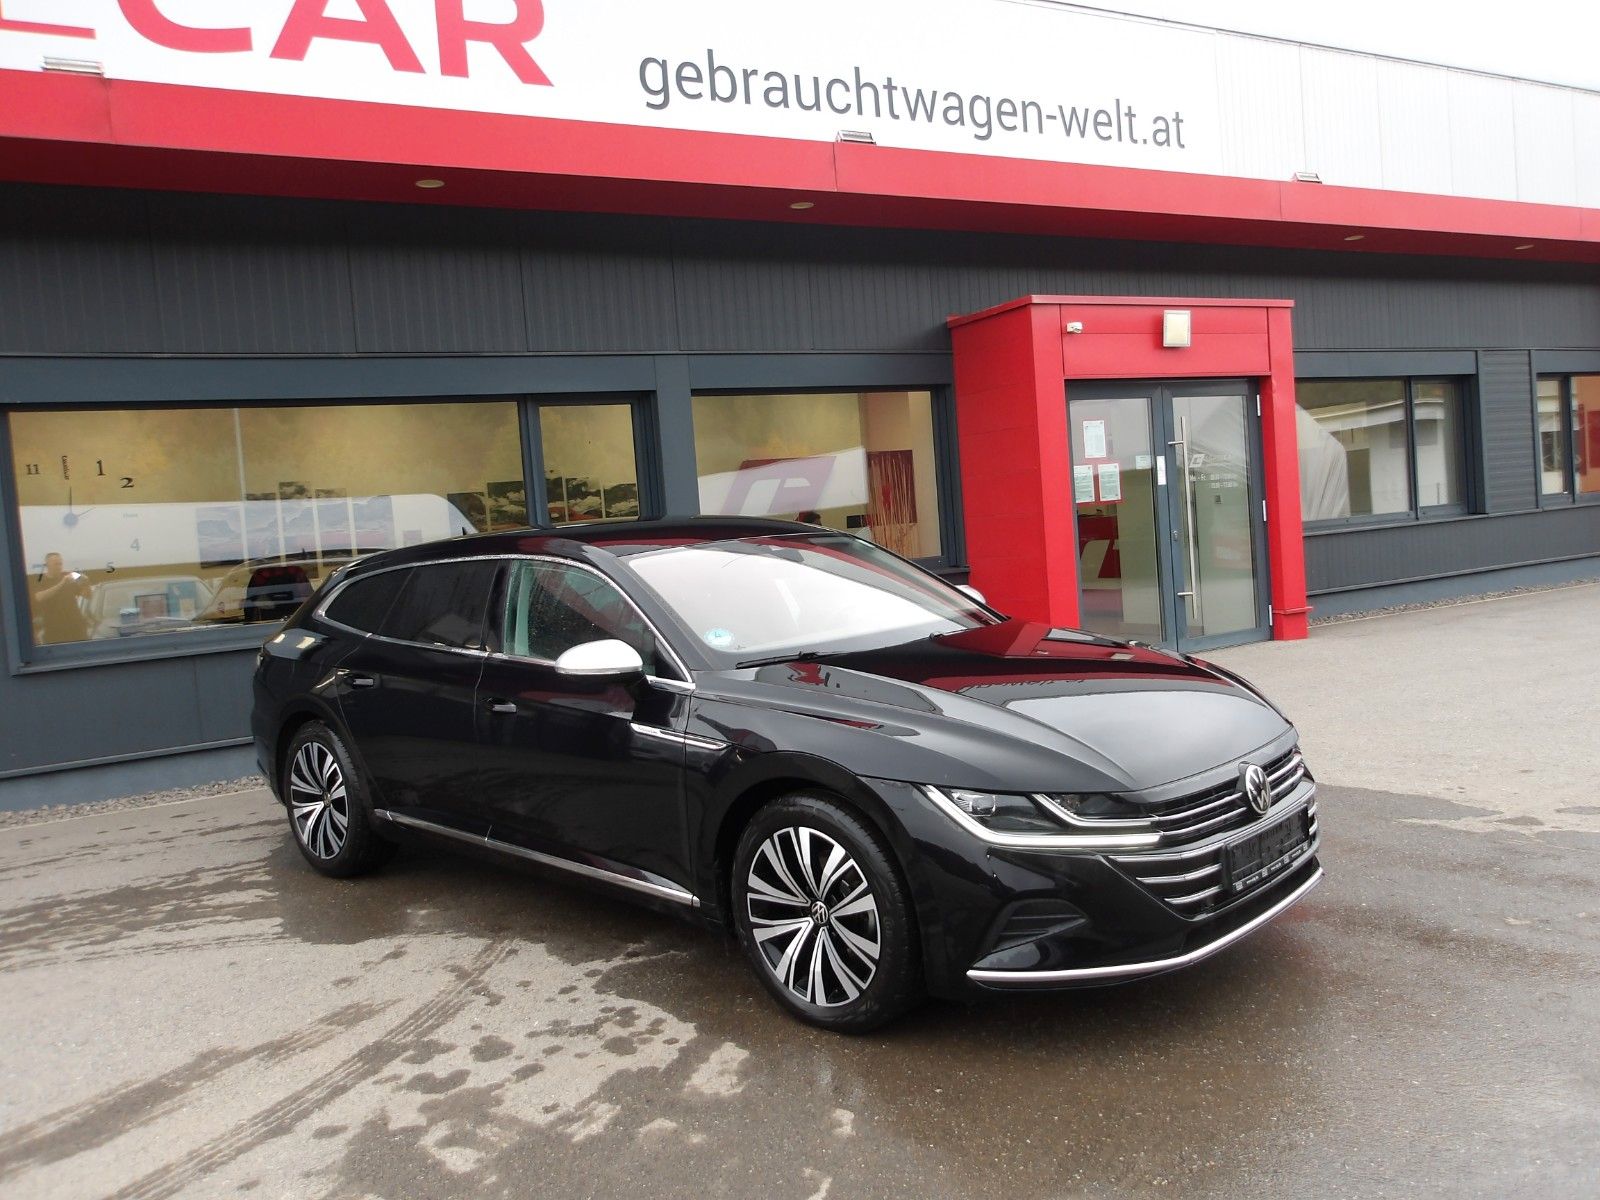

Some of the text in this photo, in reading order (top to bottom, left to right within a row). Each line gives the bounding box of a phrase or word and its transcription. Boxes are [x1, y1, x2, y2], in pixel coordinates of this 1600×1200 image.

[639, 49, 1185, 149] gebrauchtwagen-welt.at
[120, 477, 135, 489] 2
[130, 538, 141, 552] 4
